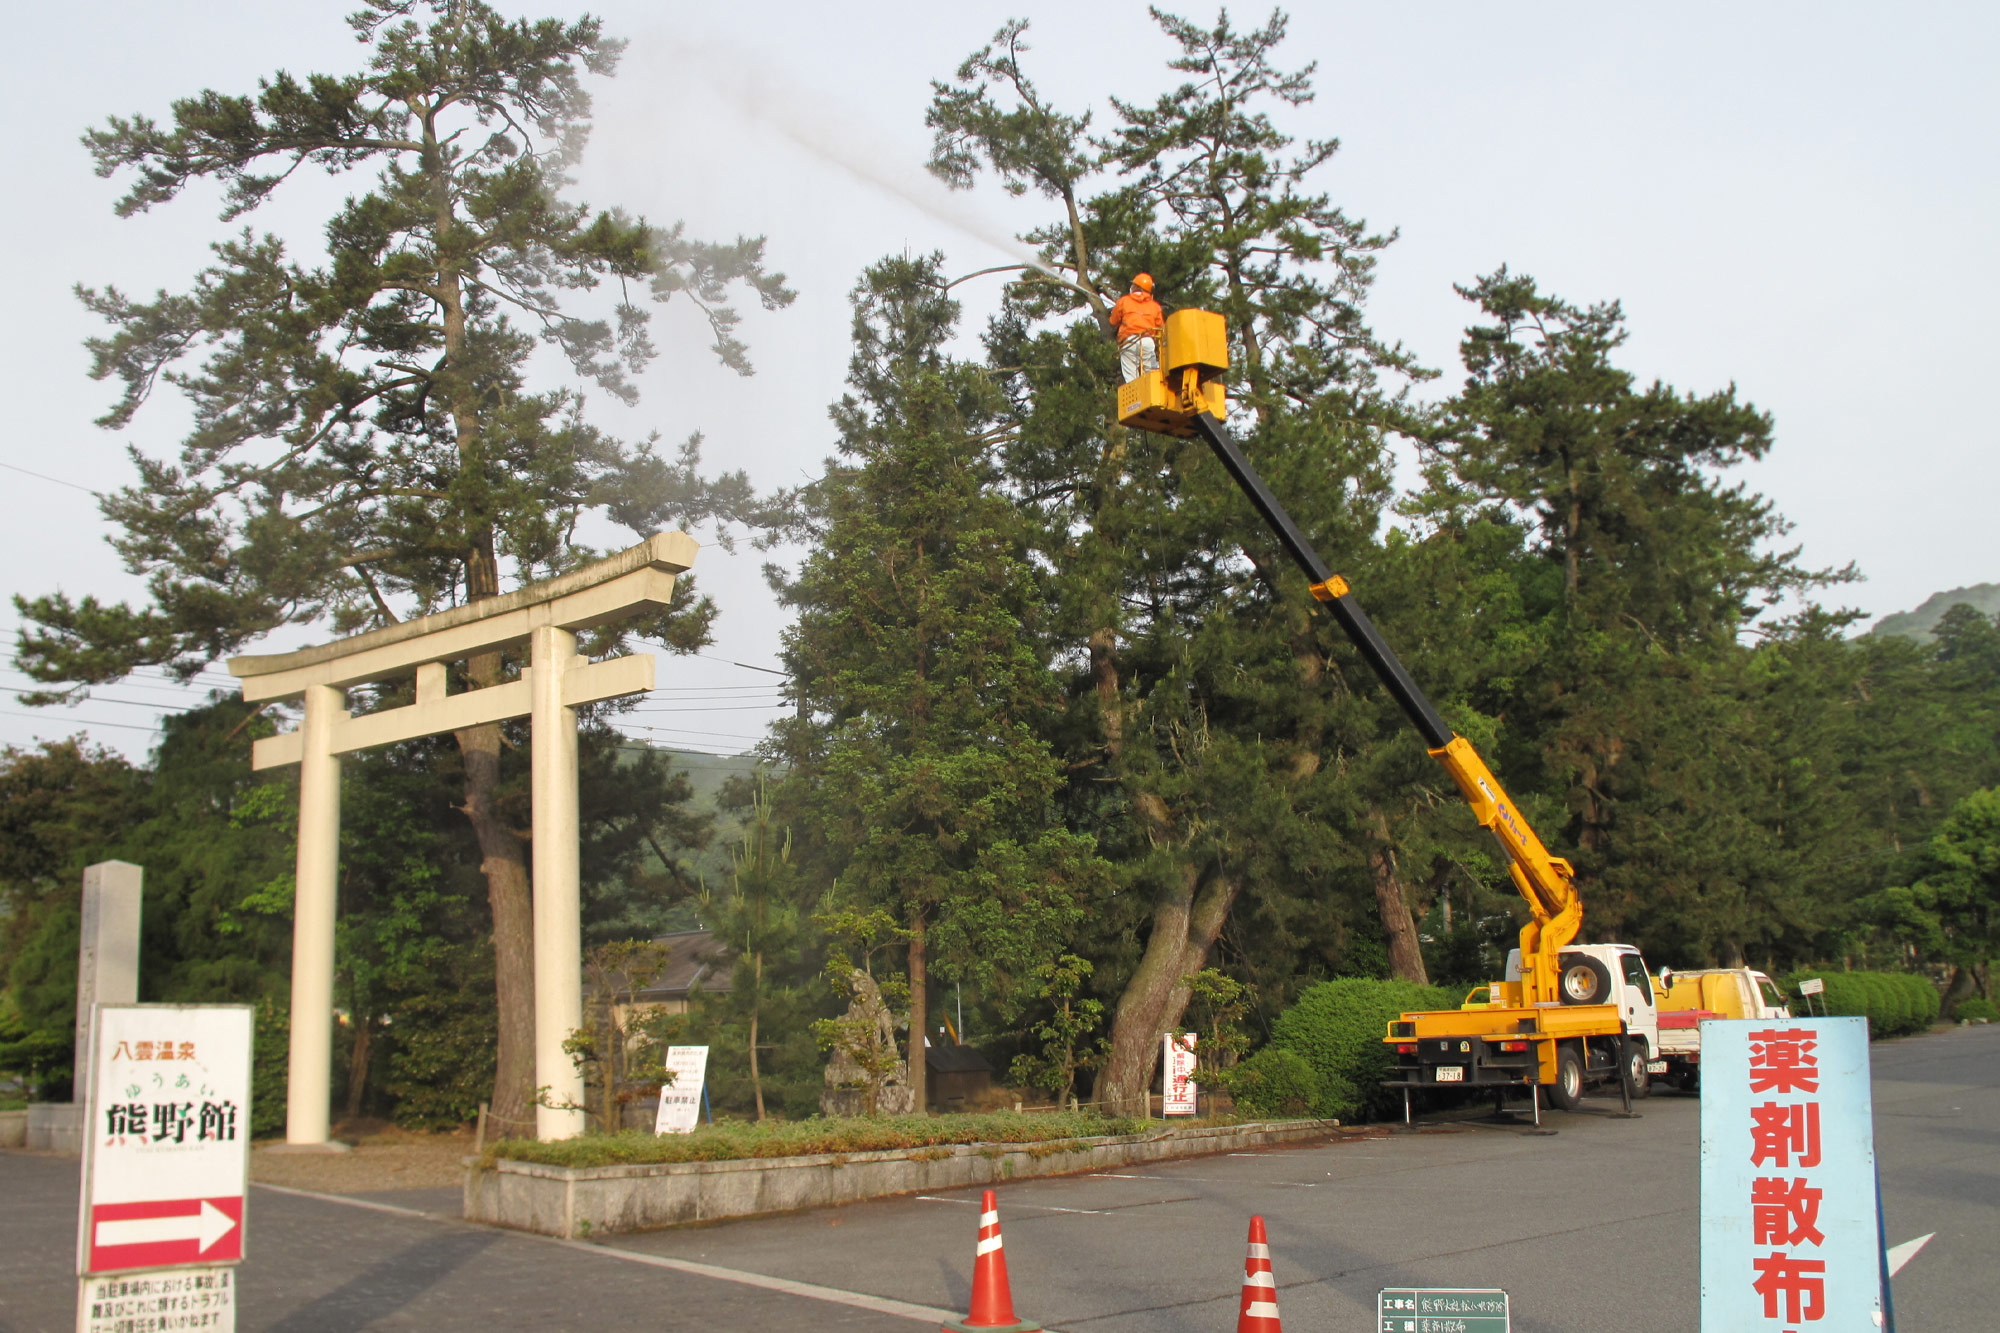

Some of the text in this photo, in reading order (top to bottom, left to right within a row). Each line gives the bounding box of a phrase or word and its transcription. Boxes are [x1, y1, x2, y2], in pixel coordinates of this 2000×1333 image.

[112, 1041, 196, 1061] 八雲温泉
[125, 1073, 215, 1099] ゆうあい
[105, 1100, 237, 1146] 熊野館
[1748, 1028, 1826, 1333] 薬剤散布
[1384, 1299, 1414, 1310] 工事名
